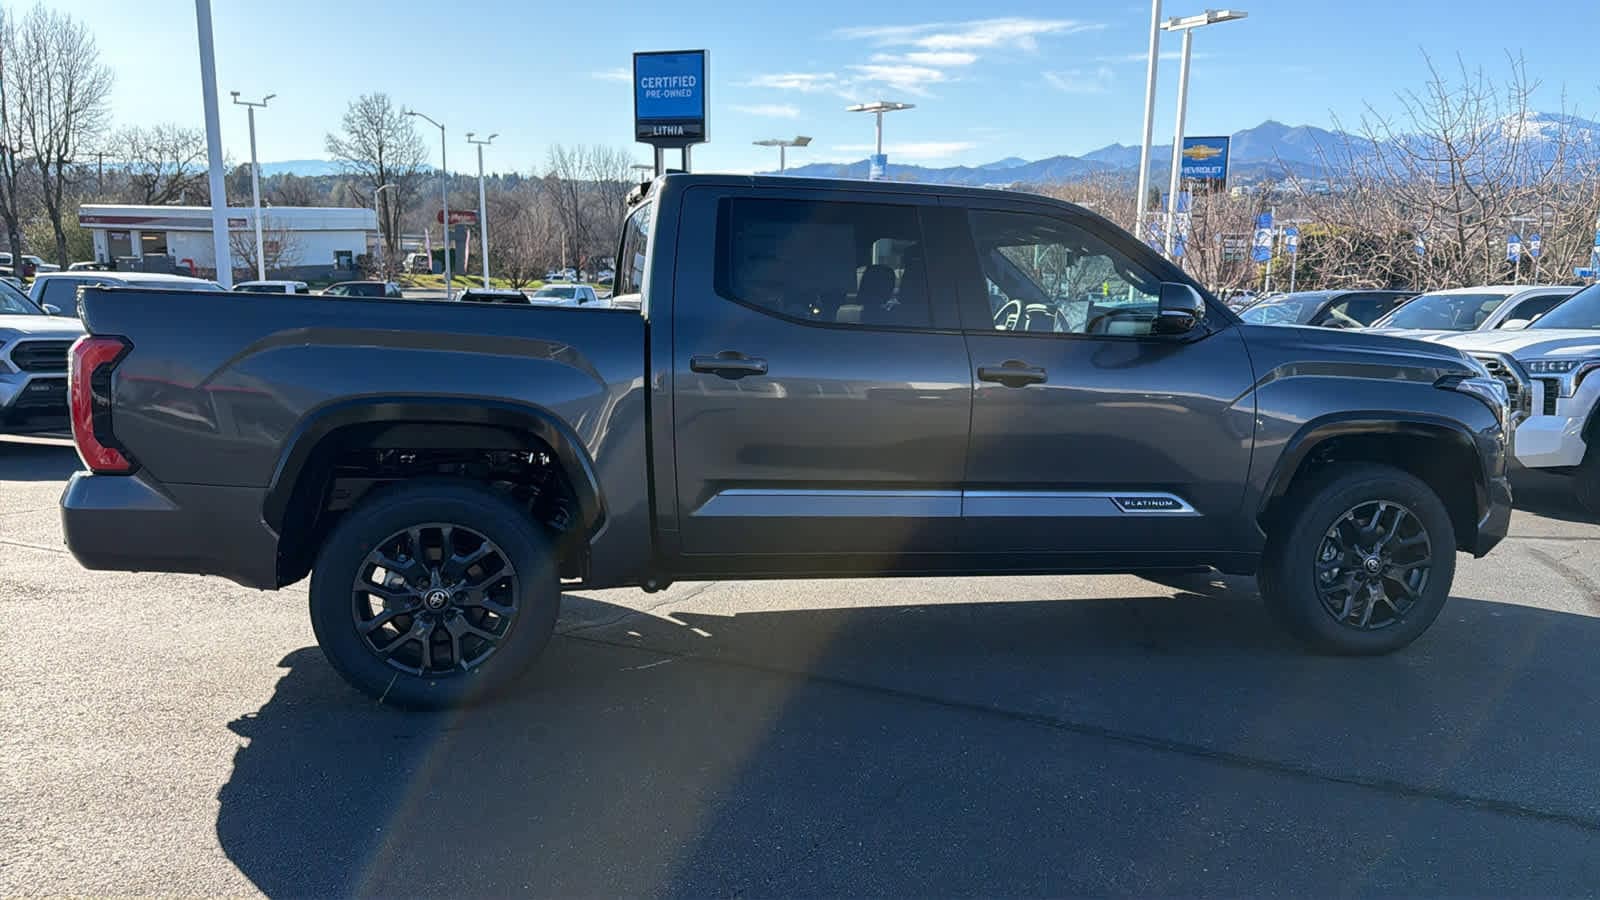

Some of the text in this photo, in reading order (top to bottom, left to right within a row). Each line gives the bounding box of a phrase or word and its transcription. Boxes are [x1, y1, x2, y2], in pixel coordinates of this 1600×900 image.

[641, 75, 697, 88] CERTIFIED
[646, 89, 692, 98] PRE-OWNED
[653, 126, 684, 136] LITHIA
[1183, 166, 1223, 174] HEVROLET
